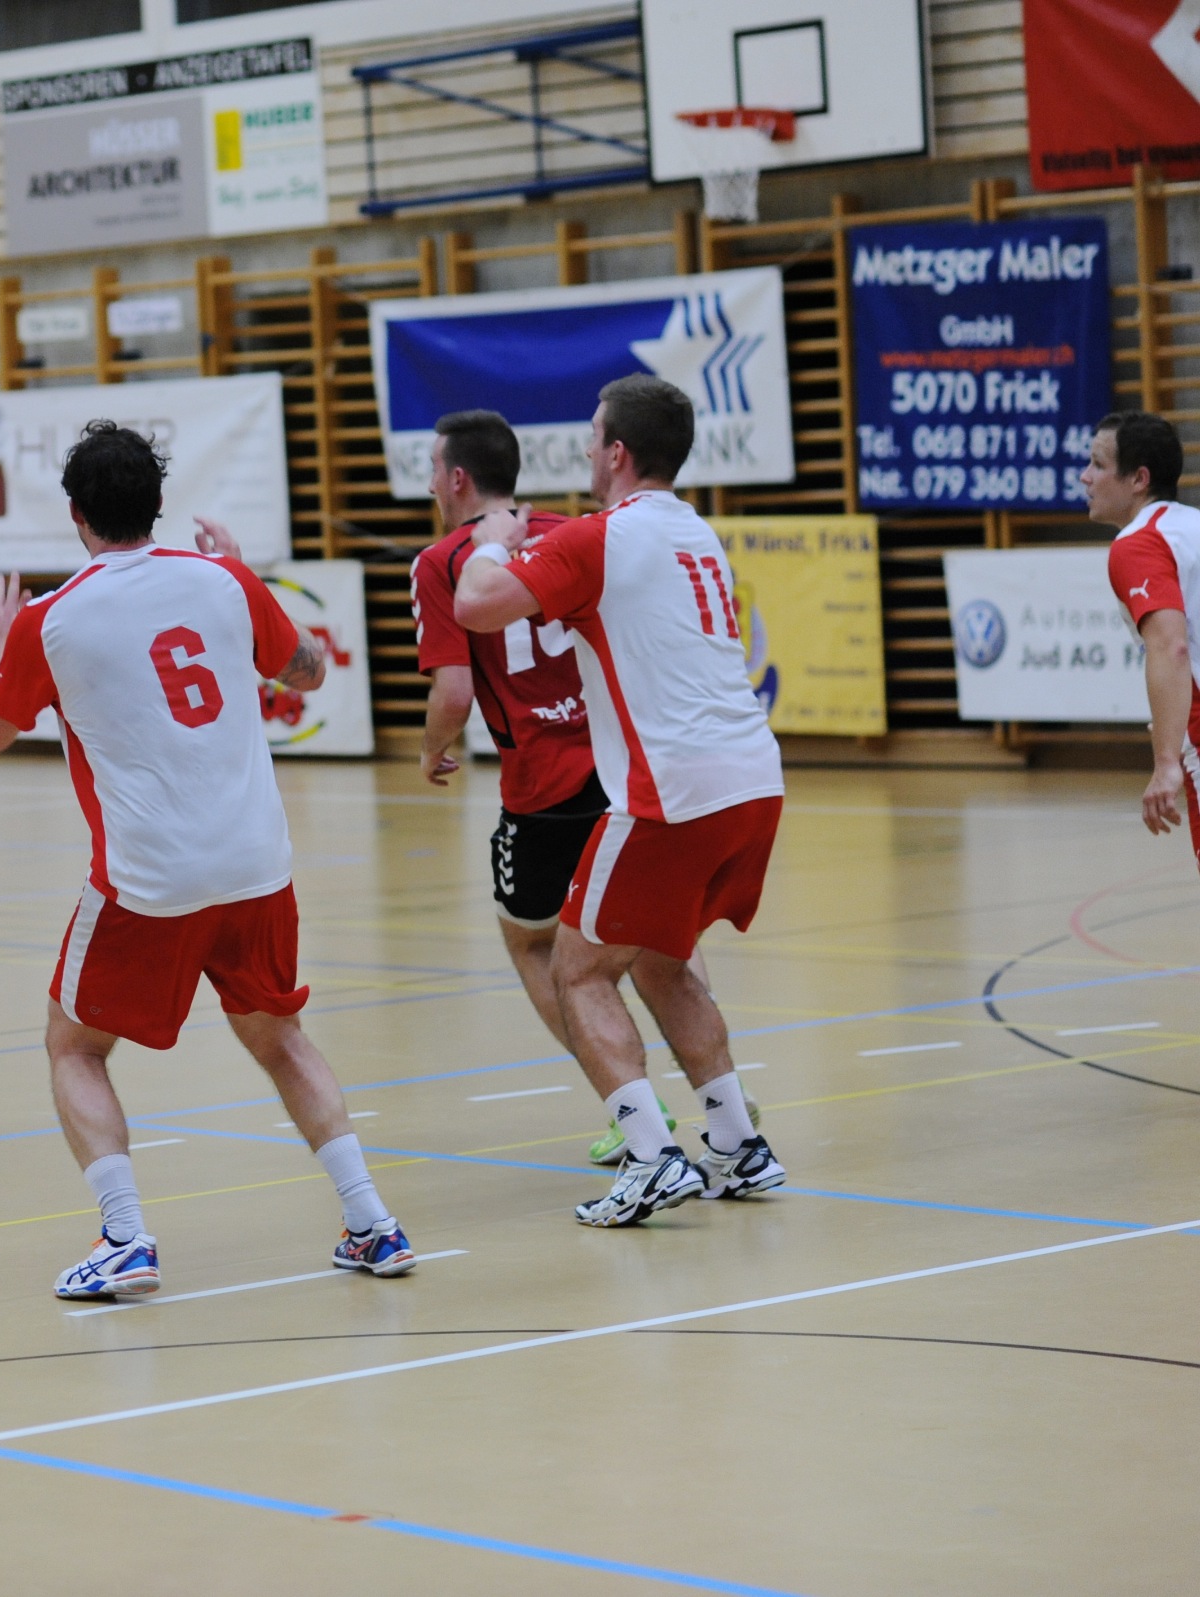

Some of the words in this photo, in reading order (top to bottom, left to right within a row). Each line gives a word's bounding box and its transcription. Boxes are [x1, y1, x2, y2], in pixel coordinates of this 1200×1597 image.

[2, 68, 129, 113] SPONSOREN
[153, 41, 310, 90] ANZEIGETAFEL
[244, 100, 314, 128] HUBER
[26, 156, 181, 199] ARCHITEKTUR
[852, 243, 994, 295] Metzger
[998, 235, 1099, 282] Maler
[939, 314, 1015, 347] GmbH
[890, 370, 978, 414] 5070
[984, 370, 1061, 414] Frick
[857, 423, 901, 460] Tel.
[911, 424, 967, 460] 062
[969, 424, 1019, 460] 871
[1023, 424, 1058, 460] 70
[911, 464, 967, 500] 079
[968, 465, 1019, 501] 360
[1022, 466, 1057, 501] 88
[674, 551, 740, 640] 11
[1019, 606, 1126, 629] Automo
[148, 626, 225, 729] 6
[1019, 645, 1061, 671] Jud
[1069, 645, 1107, 671] AG
